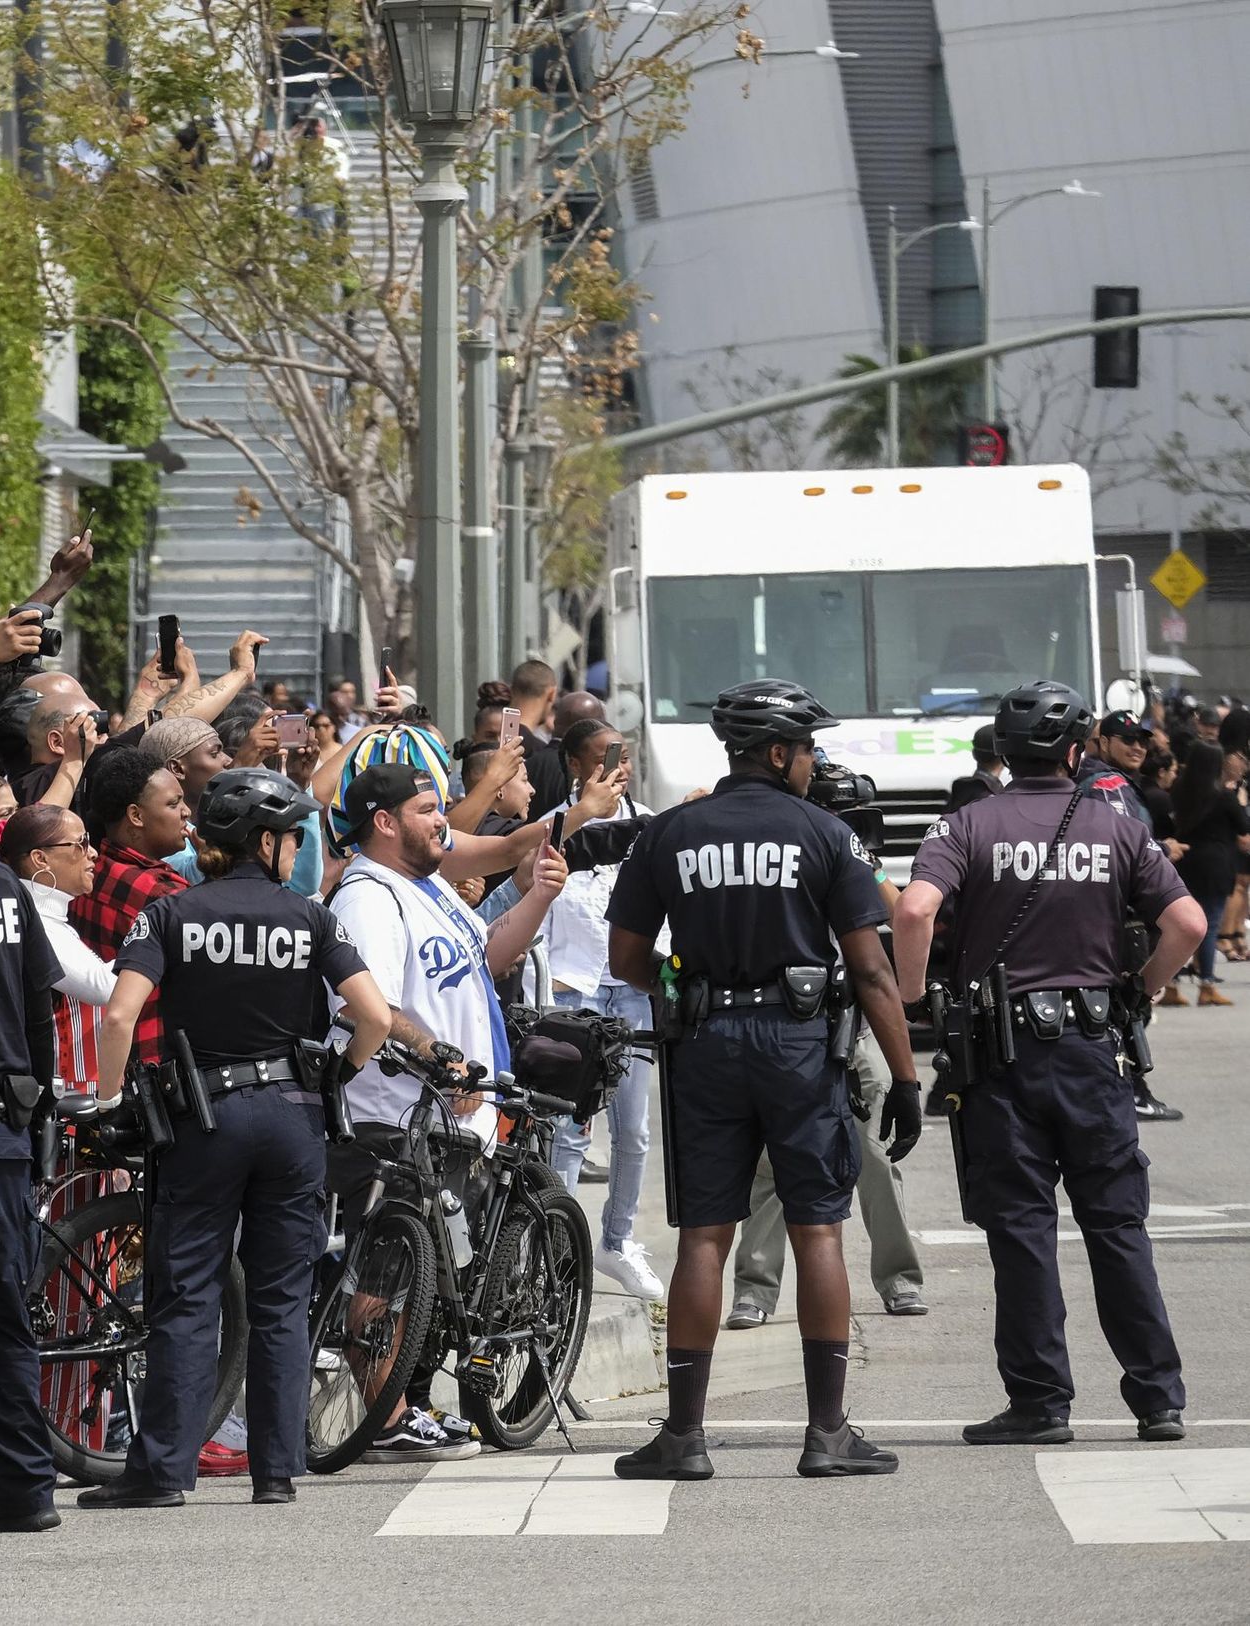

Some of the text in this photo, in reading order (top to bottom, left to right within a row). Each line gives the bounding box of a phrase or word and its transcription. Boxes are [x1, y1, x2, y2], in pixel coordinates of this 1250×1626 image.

[676, 841, 802, 894] POLICE
[992, 840, 1111, 884] POLICE
[182, 921, 312, 970] POLICE
